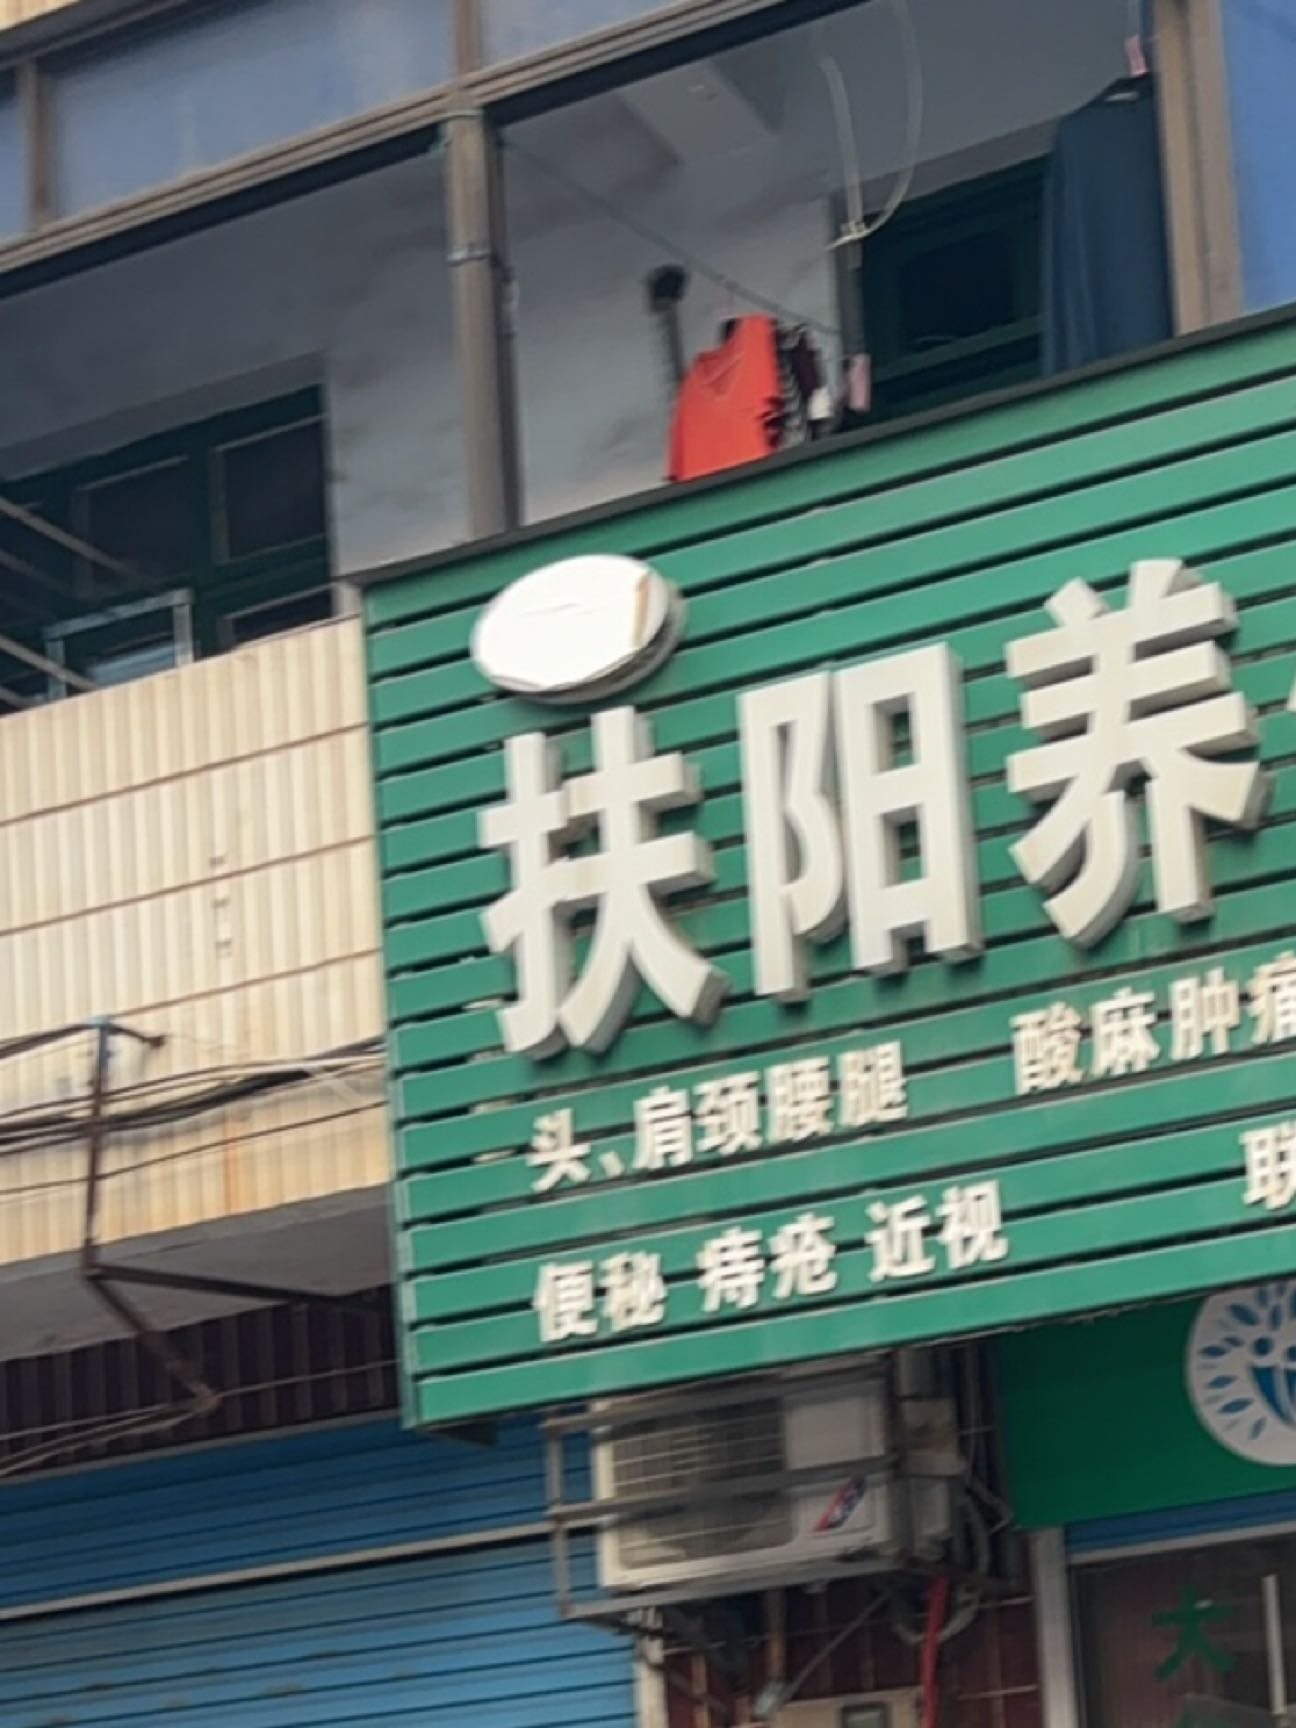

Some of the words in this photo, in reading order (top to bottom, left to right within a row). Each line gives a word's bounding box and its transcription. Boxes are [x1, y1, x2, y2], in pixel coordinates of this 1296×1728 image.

[527, 1041, 909, 1191] 头、肩颈腰腿
[532, 1258, 666, 1343] 便秘
[697, 1214, 838, 1313] 痔疮
[866, 1182, 1007, 1288] 近视
